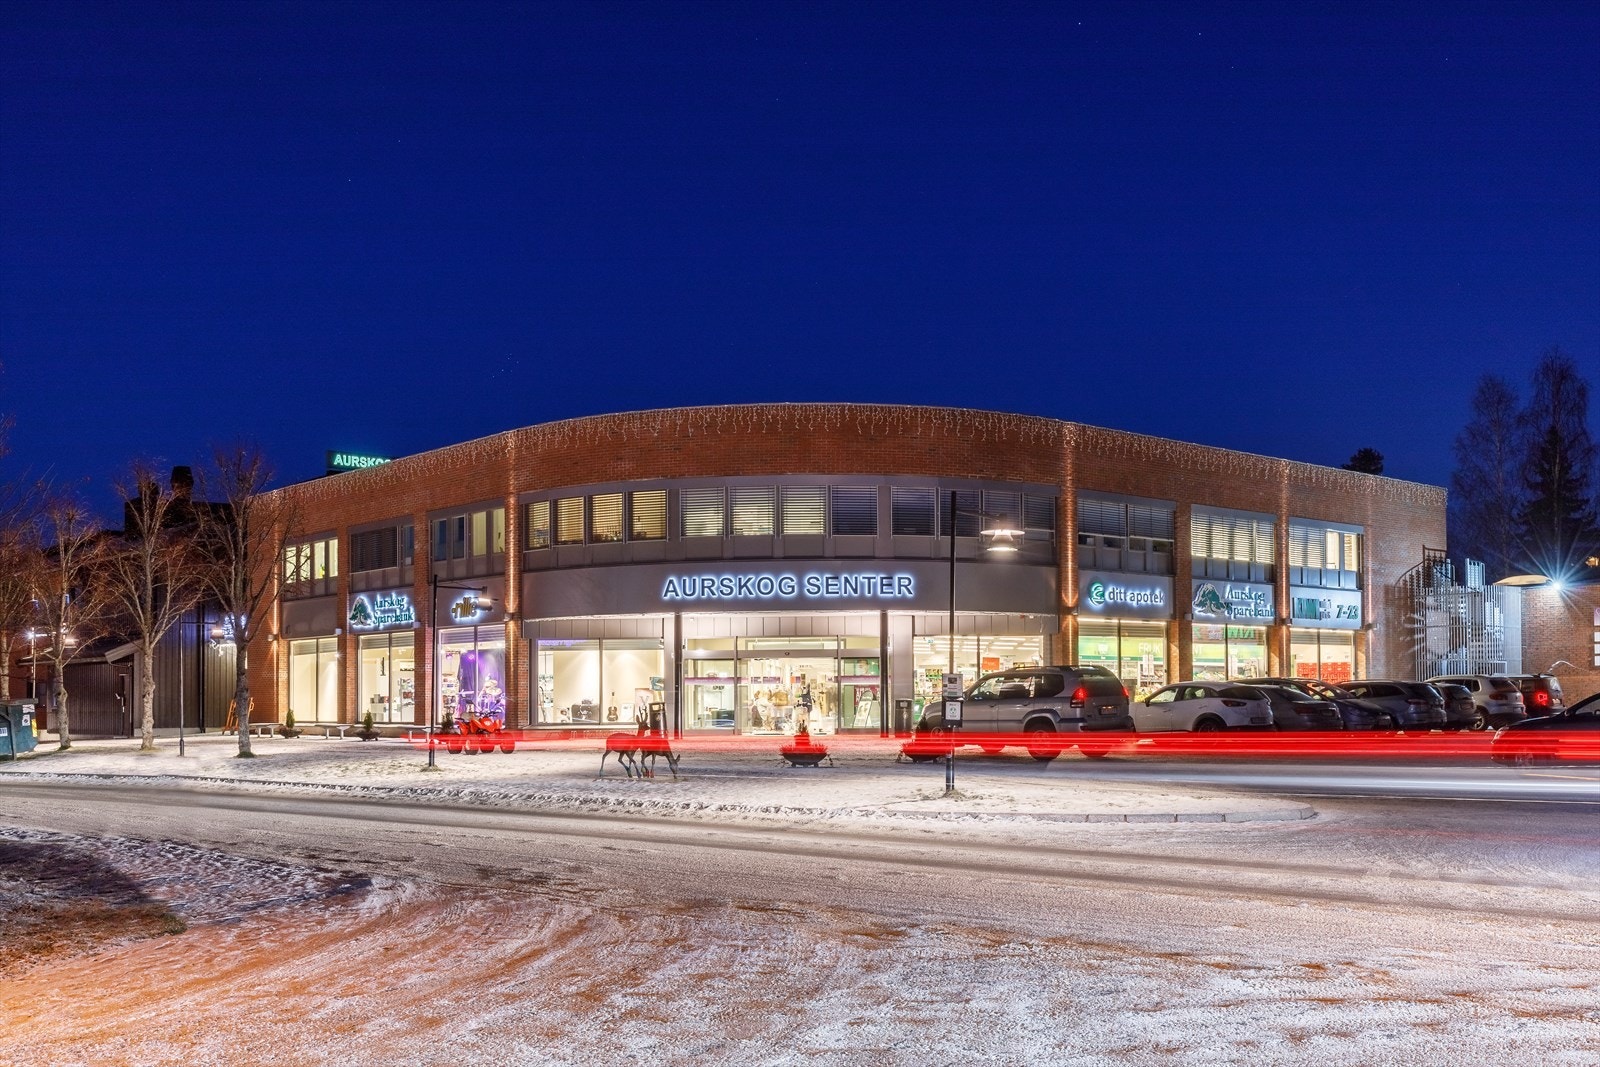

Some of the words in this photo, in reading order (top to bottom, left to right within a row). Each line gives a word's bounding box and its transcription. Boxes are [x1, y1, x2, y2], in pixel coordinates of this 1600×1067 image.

[333, 453, 391, 468] AURSKO
[663, 576, 796, 598] AURSKOG
[805, 575, 913, 596] SENTER
[1108, 586, 1127, 602] ditt
[1129, 589, 1165, 606] apotek
[1226, 586, 1266, 604] Aurskog
[373, 606, 414, 628] Sparebank
[1226, 601, 1275, 620] Sparebank
[1336, 604, 1359, 620] 7-23
